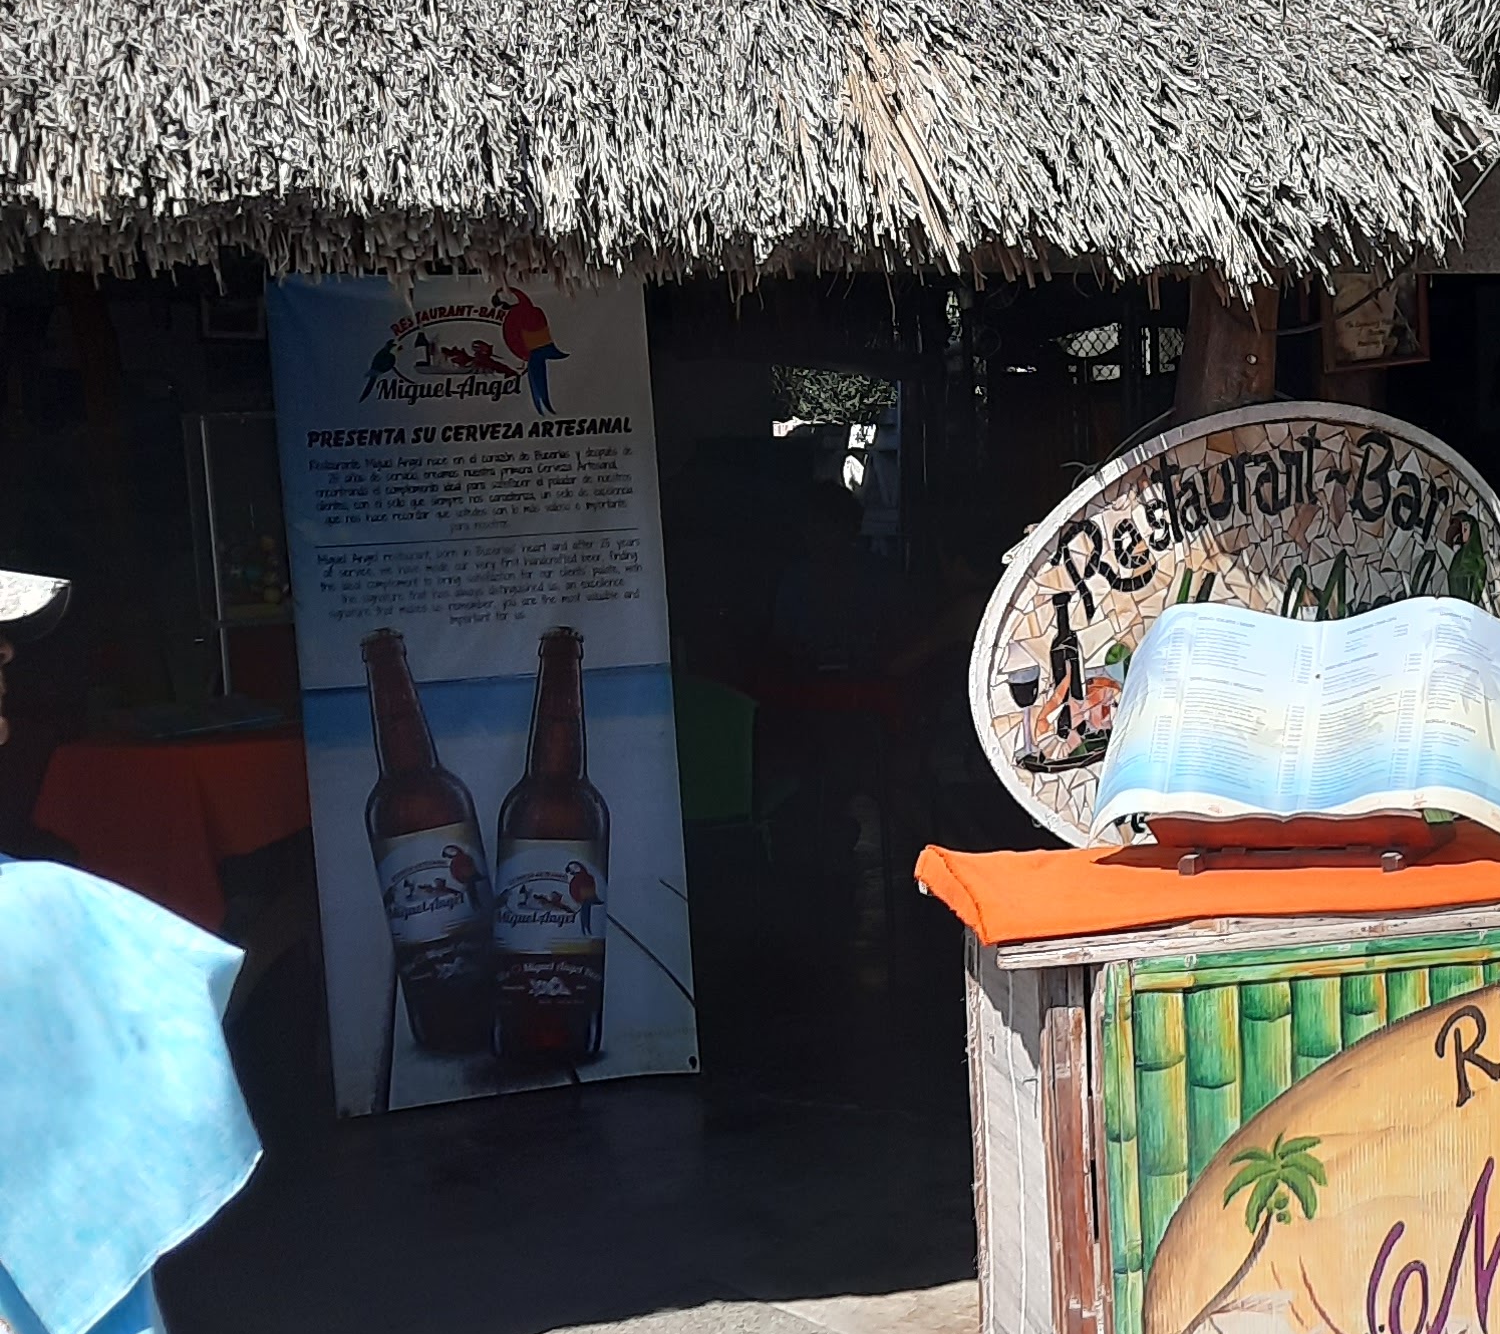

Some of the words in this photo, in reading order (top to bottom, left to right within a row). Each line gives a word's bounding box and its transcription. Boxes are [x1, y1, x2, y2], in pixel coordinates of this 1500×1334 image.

[376, 378, 452, 406] Miguel
[450, 374, 522, 402] Angel
[307, 428, 406, 449] PRESENTA
[411, 425, 439, 444] SU
[441, 422, 523, 443] CERVEZA
[528, 417, 633, 438] ARTESANAL
